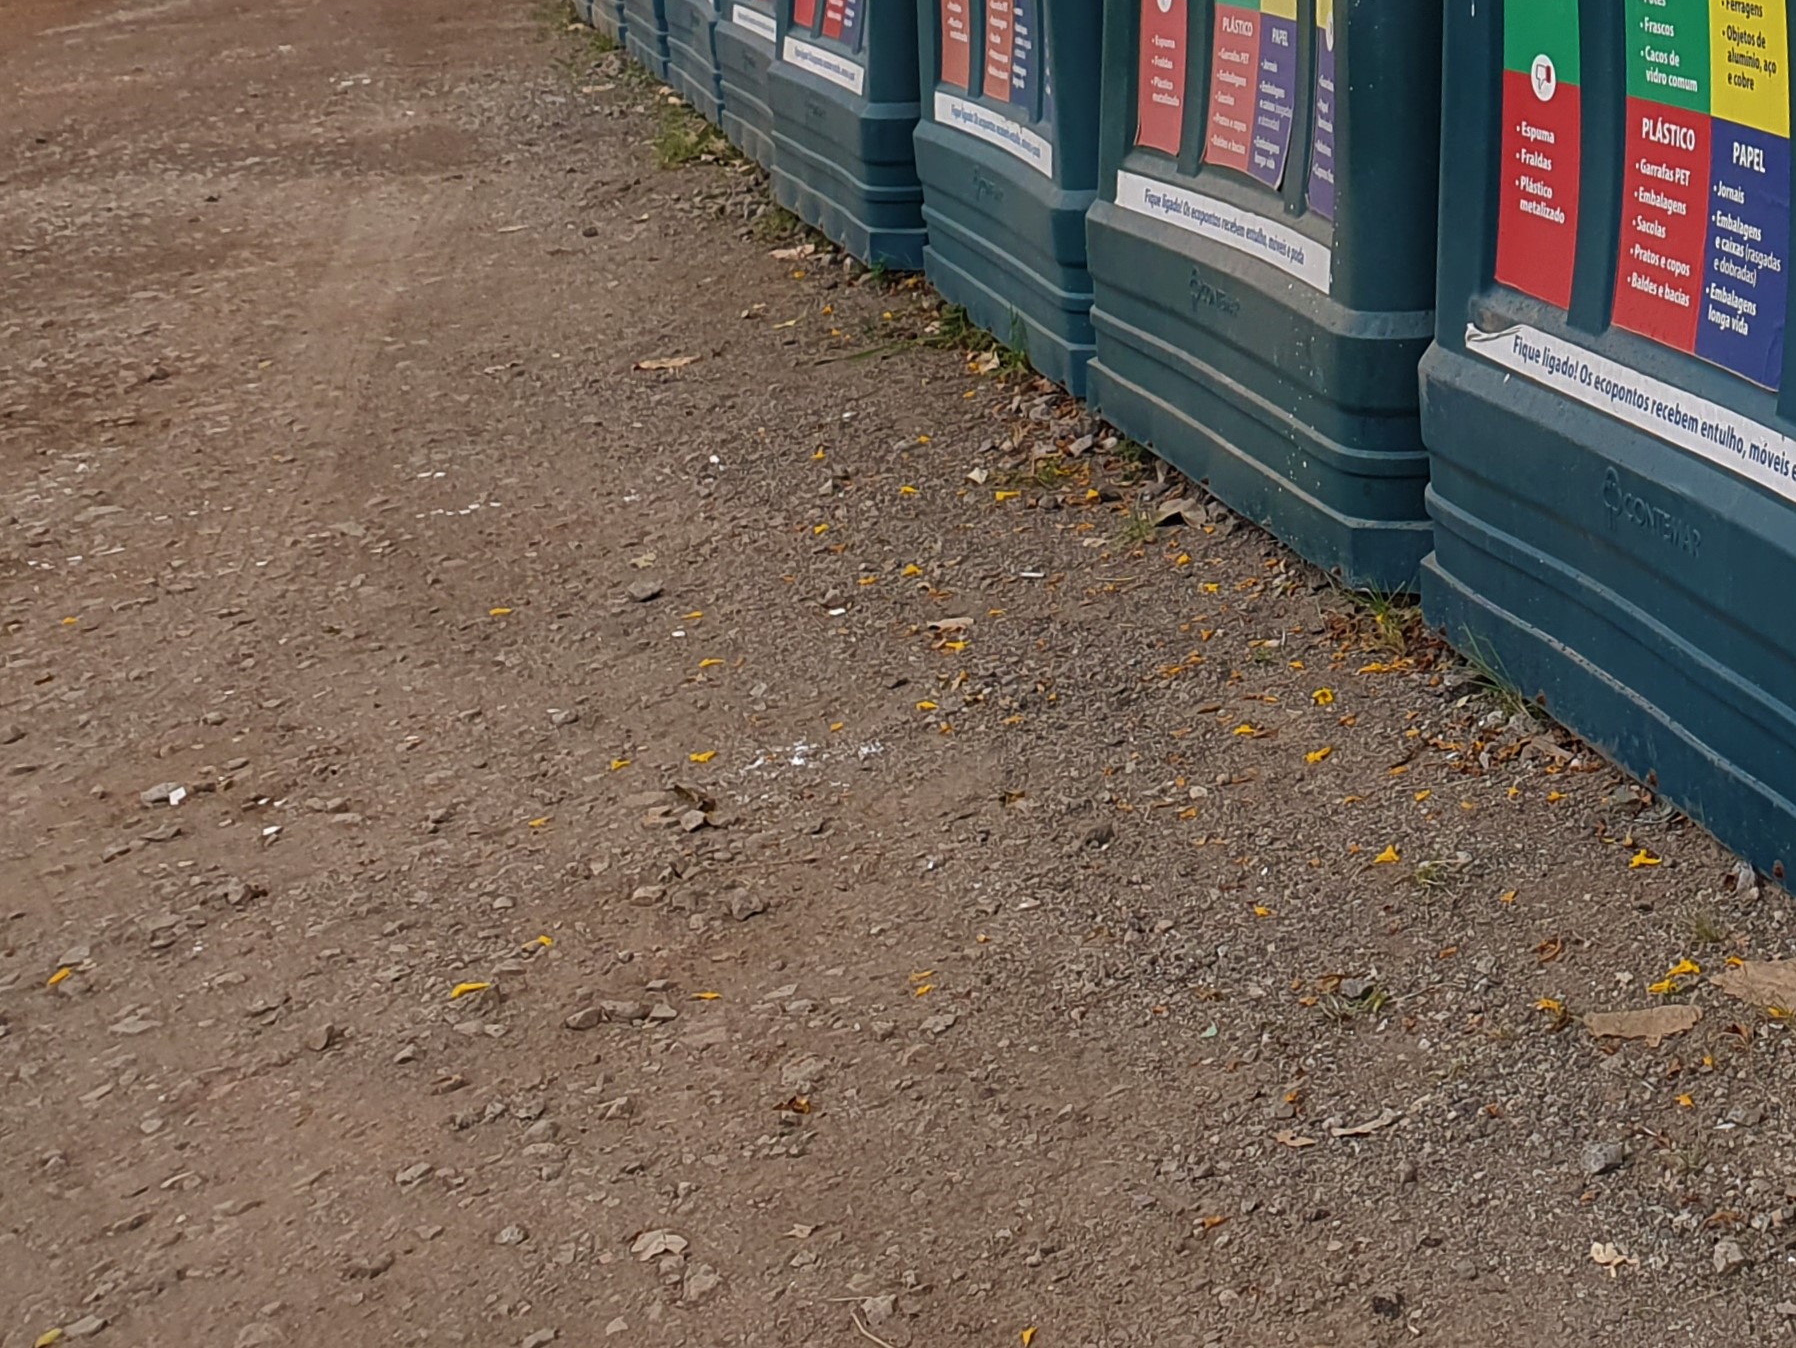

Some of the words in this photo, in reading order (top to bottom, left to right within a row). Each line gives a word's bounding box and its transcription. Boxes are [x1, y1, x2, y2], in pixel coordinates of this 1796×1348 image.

[1222, 15, 1252, 37] PLÁSTICO
[1272, 28, 1288, 47] PAPEL
[1521, 122, 1555, 144] Espuma
[1642, 117, 1696, 151] PLÁSTICO
[1521, 149, 1552, 171] Fraldas
[1733, 142, 1765, 173] PAPEL
[1520, 176, 1552, 199] Plástico
[1520, 199, 1565, 224] metalizado
[1513, 334, 1541, 364] Fique
[1542, 346, 1579, 381] ligado!
[1579, 364, 1594, 388] Os
[1594, 373, 1650, 414] ecopontos
[1650, 397, 1699, 434] recebem
[1701, 418, 1747, 457] entulho,
[1749, 440, 1789, 476] móveis
